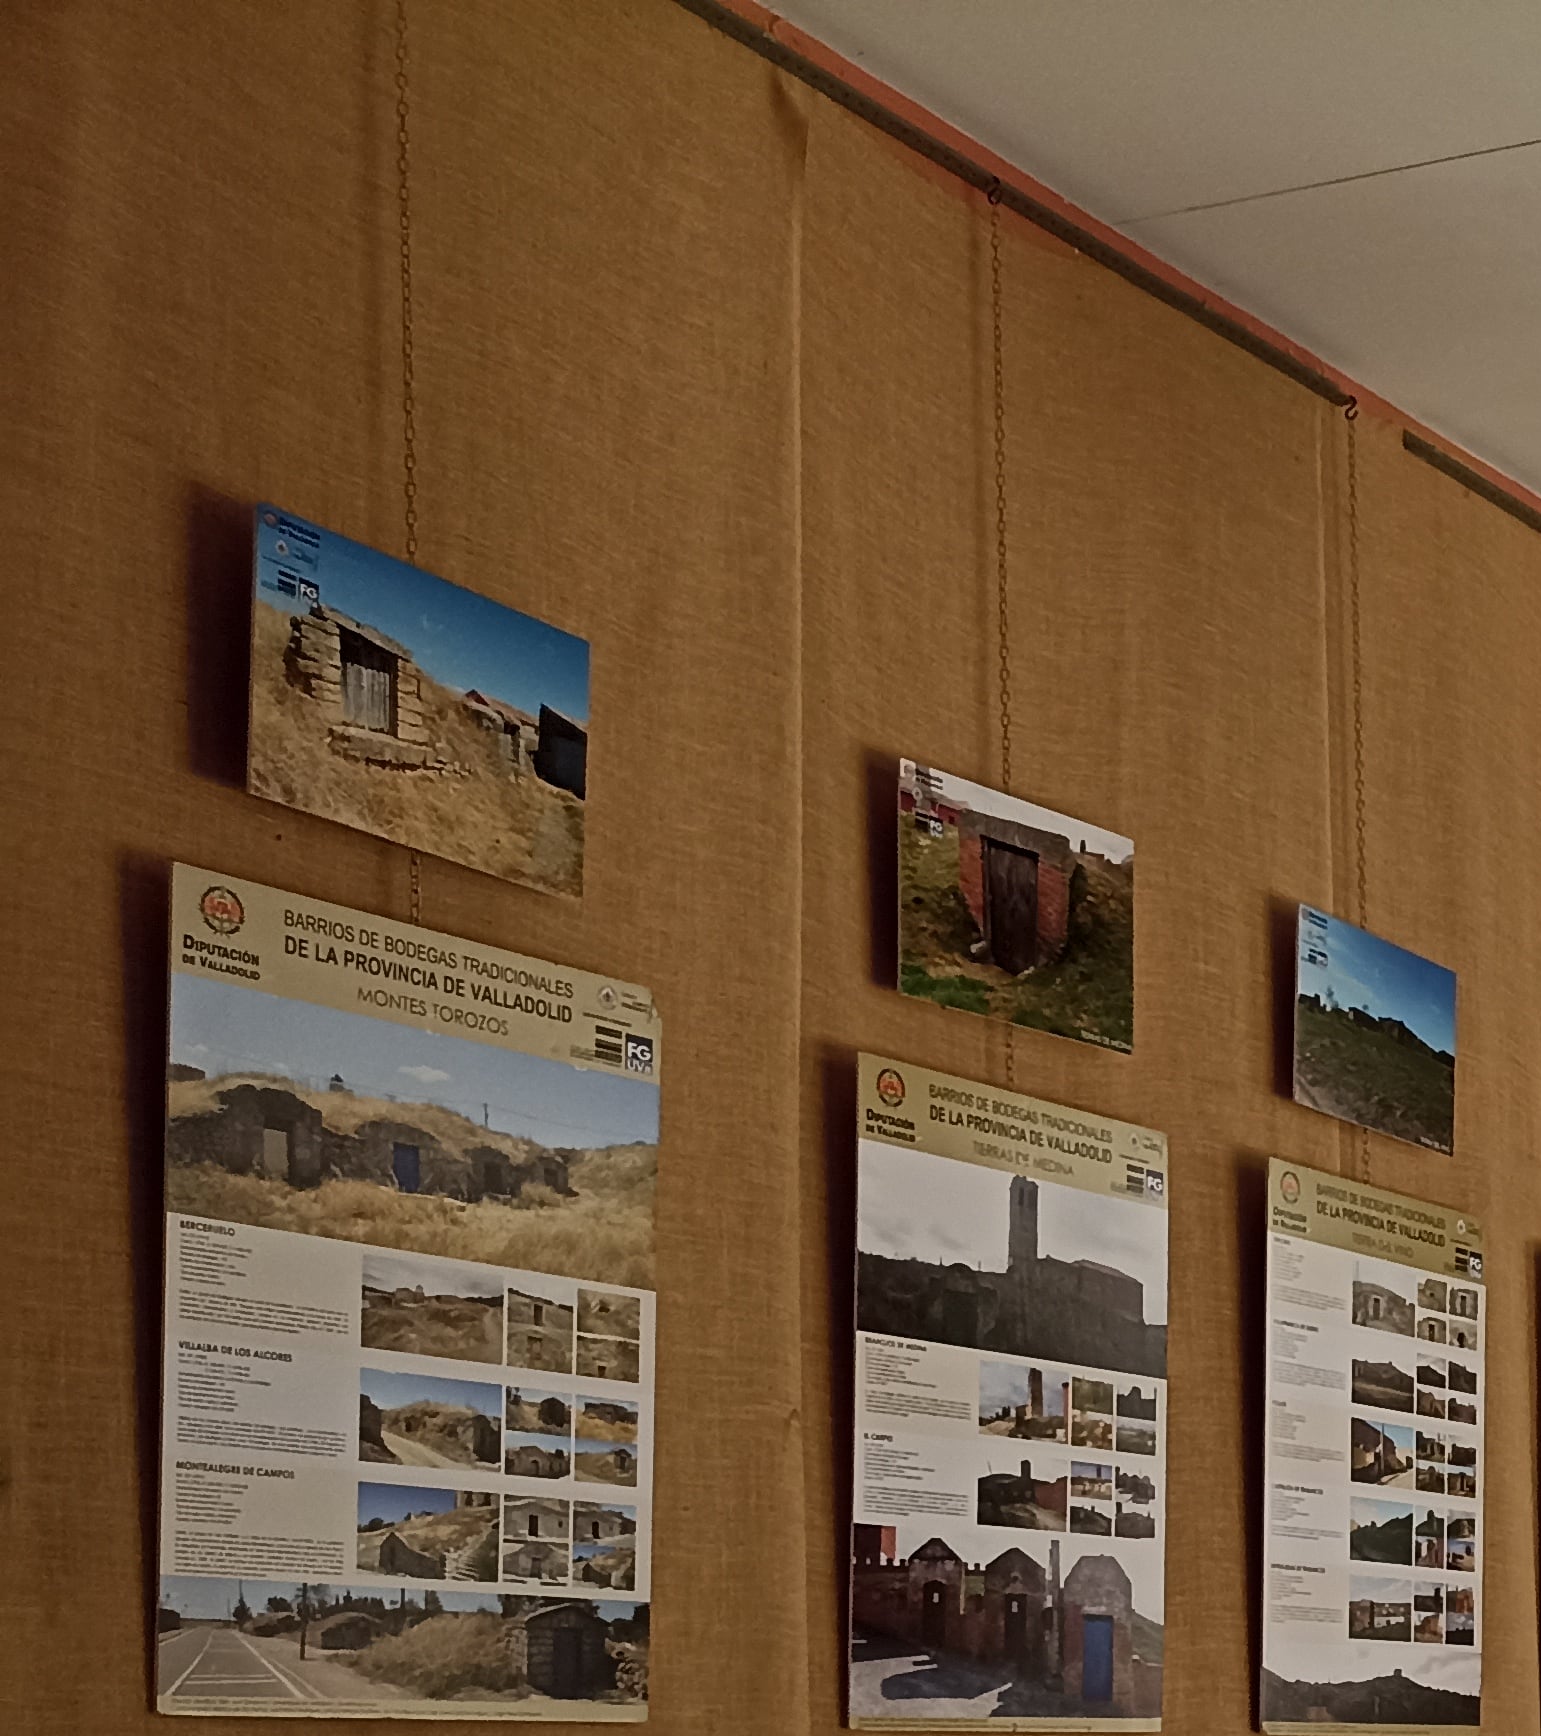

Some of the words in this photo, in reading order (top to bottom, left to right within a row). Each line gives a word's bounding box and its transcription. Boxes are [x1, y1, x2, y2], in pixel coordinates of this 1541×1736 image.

[199, 956, 261, 981] VALLADOLID
[284, 909, 355, 943] BARRIOS
[358, 929, 380, 949] DE
[384, 935, 458, 968] BODEGAS
[462, 955, 574, 999] TRADICIONALES
[284, 935, 310, 959] DE
[315, 943, 339, 965] LA
[343, 950, 439, 990] PROVINCIA
[443, 975, 465, 997] DE
[471, 983, 573, 1023] VALLADOLID
[357, 987, 427, 1017] MONTES
[433, 1003, 509, 1036] TOROZOS
[627, 1041, 652, 1061] FG
[929, 1083, 975, 1108] BARRIOS
[976, 1097, 989, 1112] DE
[992, 1100, 1039, 1125] BODEGAS
[1041, 1112, 1113, 1144] TRADICIONALES
[929, 1104, 946, 1122] DE
[949, 1110, 964, 1126] LA
[966, 1114, 1027, 1142] PROVINCIA
[1029, 1130, 1045, 1148] DE
[1046, 1135, 1113, 1164] VALLADOLID
[1316, 1200, 1329, 1215] DE
[1330, 1204, 1340, 1218] LA
[1386, 1220, 1399, 1235] DE
